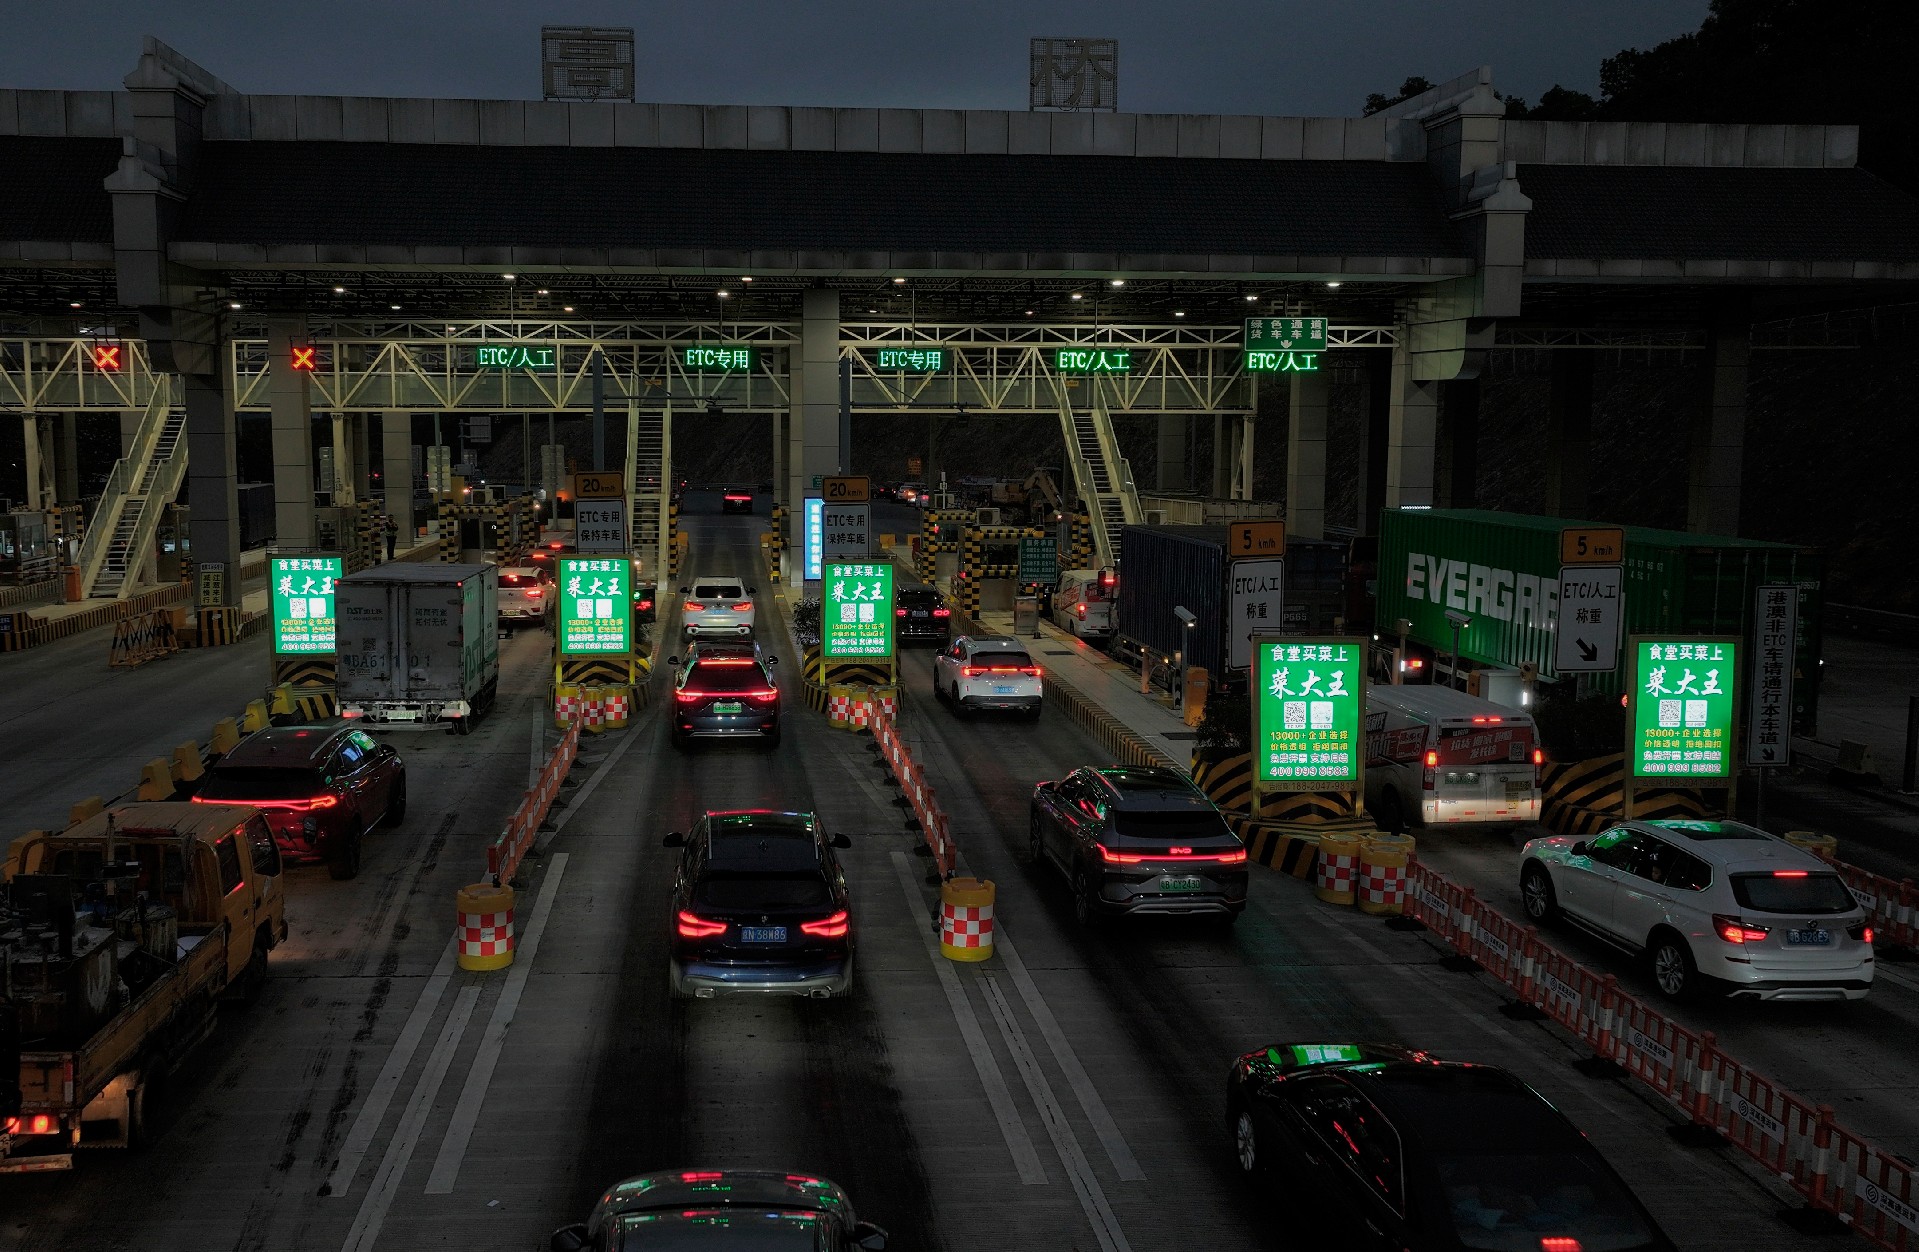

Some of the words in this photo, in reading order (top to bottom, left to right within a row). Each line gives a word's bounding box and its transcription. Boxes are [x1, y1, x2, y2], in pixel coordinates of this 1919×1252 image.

[1031, 38, 1115, 107] 桥
[1251, 320, 1322, 329] 绿色通道
[1251, 330, 1322, 339] 货车车道
[479, 348, 554, 367] ETC/人工
[686, 349, 749, 369] ETC专用
[879, 350, 941, 370] ETC专用
[1059, 351, 1129, 370] ETC/人工
[1249, 352, 1318, 371] ETC/人工
[582, 479, 600, 492] 20
[830, 483, 846, 497] 20
[580, 511, 620, 523] ETC专用
[827, 515, 865, 526] ETC专用
[581, 530, 620, 541] 保持车距
[827, 533, 866, 544] 保持车距
[1243, 530, 1252, 549] 5
[1577, 536, 1588, 555] 5
[1235, 576, 1279, 594] ETC/人工
[1406, 551, 1560, 632] EVERGRE
[1564, 582, 1617, 599] ETC/人工
[1247, 602, 1268, 619] 称重
[1576, 607, 1602, 624] 称重
[1271, 644, 1349, 662] 食堂买菜上
[1650, 643, 1724, 660] 食堂买菜上
[1269, 666, 1350, 700] 菜大王
[1645, 665, 1723, 698] 菜大王
[1269, 765, 1293, 776] 400
[1294, 765, 1317, 776] 999
[1643, 762, 1666, 773] 400
